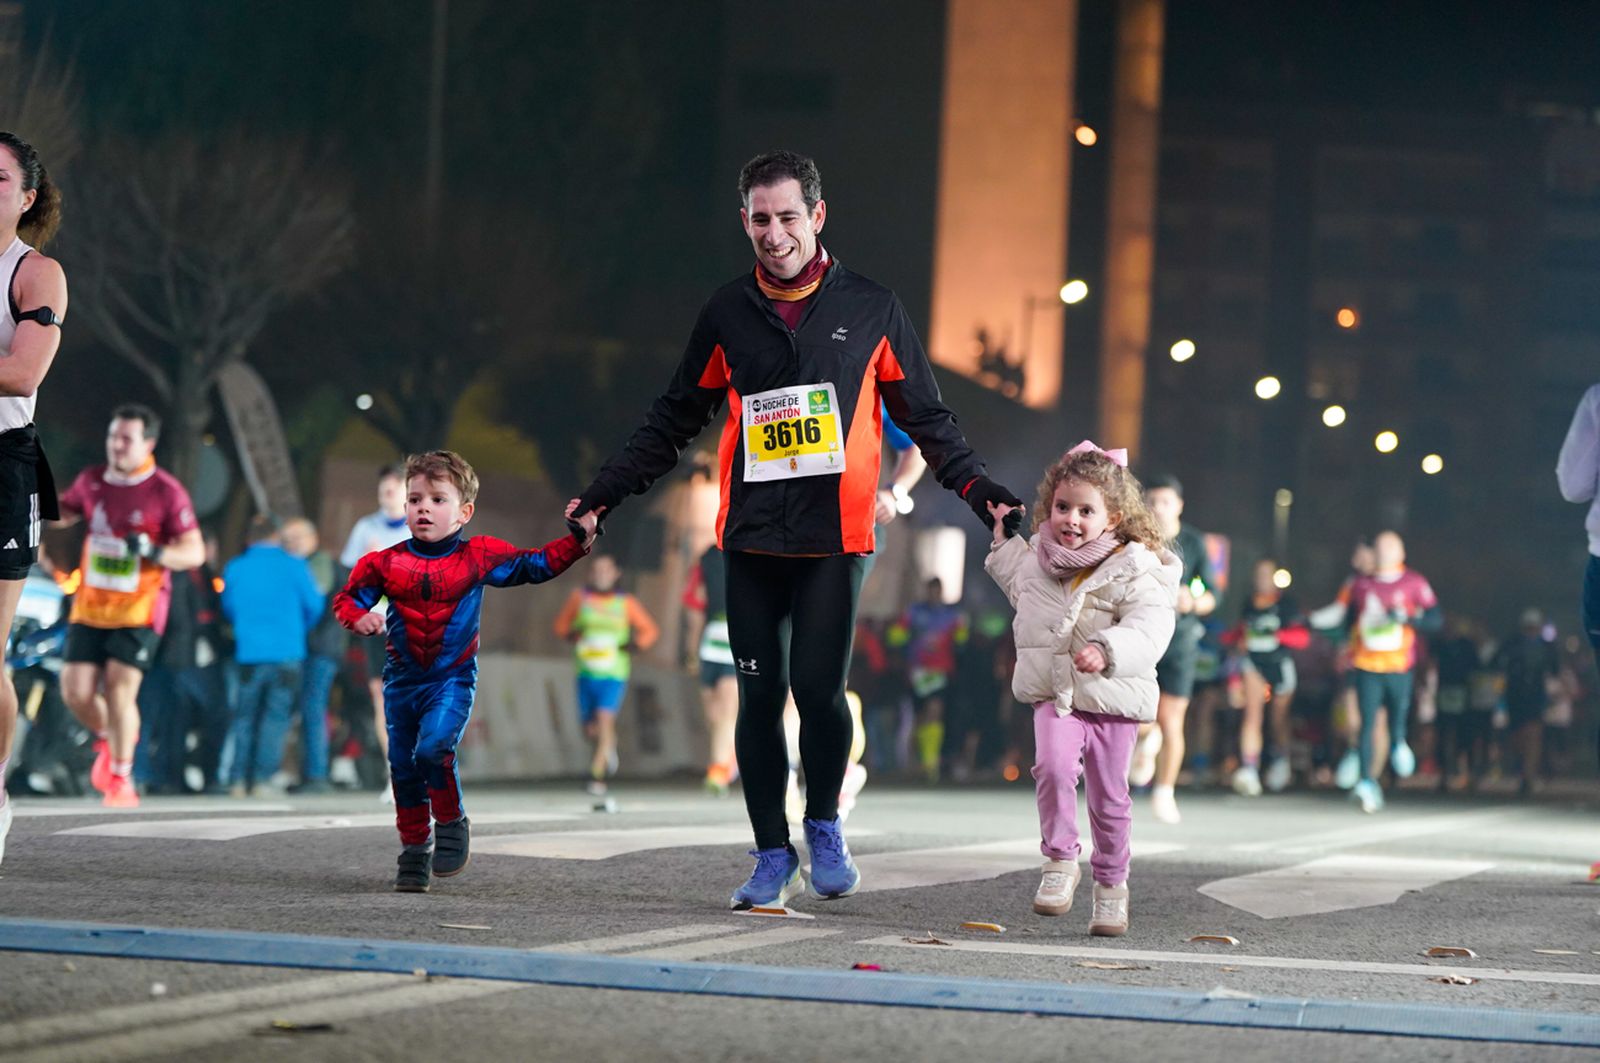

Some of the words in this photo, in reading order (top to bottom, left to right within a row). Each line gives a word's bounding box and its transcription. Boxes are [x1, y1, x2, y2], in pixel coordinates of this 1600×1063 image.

[762, 398, 787, 411] NOCHE
[788, 396, 799, 406] DE
[753, 412, 771, 425] SAN
[763, 417, 821, 451] 3616
